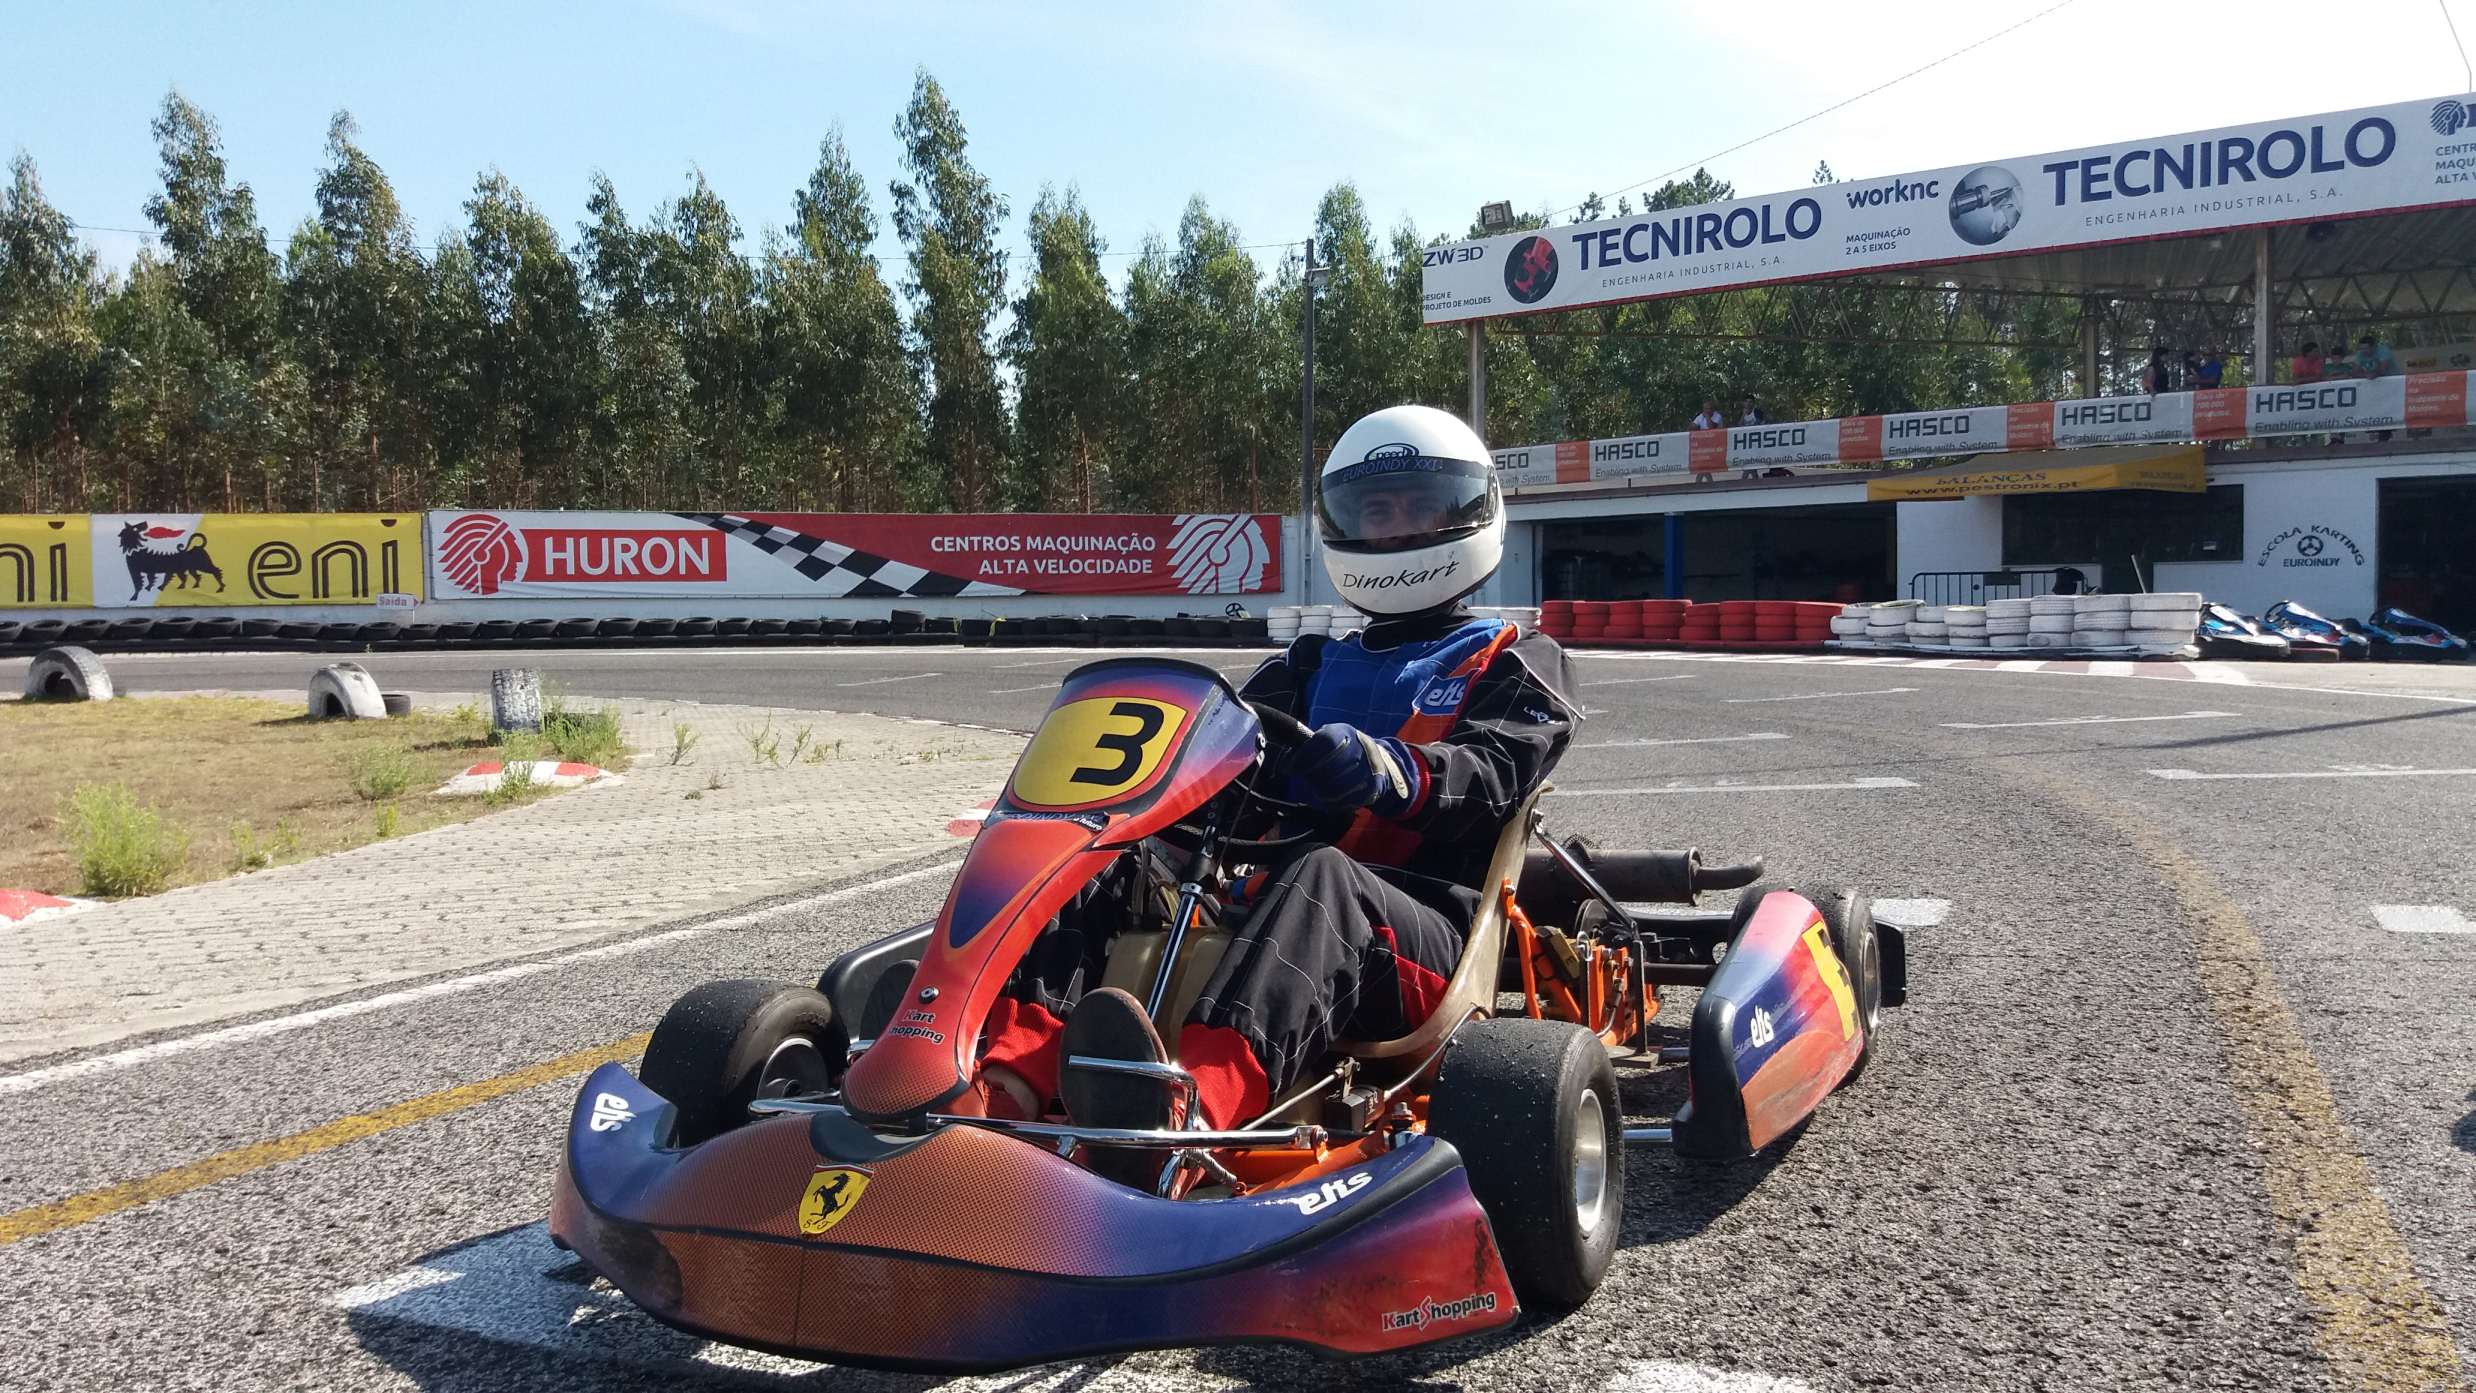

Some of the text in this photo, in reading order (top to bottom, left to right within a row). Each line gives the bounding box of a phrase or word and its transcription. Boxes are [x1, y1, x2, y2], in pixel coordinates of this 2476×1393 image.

[2042, 116, 2397, 207] TECNIROLO
[2435, 172, 2468, 184] ALTA
[1846, 178, 1939, 209] worknc
[2085, 205, 2186, 227] ENGENHARIA
[2310, 185, 2344, 200] S.A.
[1572, 197, 1822, 271] TECNIROLO
[1846, 227, 1911, 244] MAQUINAÇÃO
[1846, 241, 1897, 255] 2 A 5 EIXOS
[1602, 270, 1675, 288] ENGENHARIA
[1453, 299, 1462, 308] DE
[1464, 296, 1492, 306] MOLDES
[2255, 387, 2357, 414] HASCO
[2061, 402, 2152, 426] HASCO
[2255, 415, 2393, 433] Enabling with System
[1888, 415, 1970, 439] HASCO
[1733, 428, 1806, 450] HASCO
[1491, 453, 1529, 470] SCO
[1595, 441, 1660, 462] HASCO
[931, 532, 1156, 555] CENTROS MAQUINAÇÃO
[2258, 525, 2365, 567] ESCOLA KARTING
[247, 518, 400, 599] eni
[545, 536, 711, 576] HURON
[979, 558, 1153, 575] ALTA VELOCIDADE
[2283, 557, 2341, 568] EUROINDY
[1342, 560, 1460, 589] Dinokart
[1069, 702, 1165, 786] 3
[903, 1009, 936, 1024] Kart
